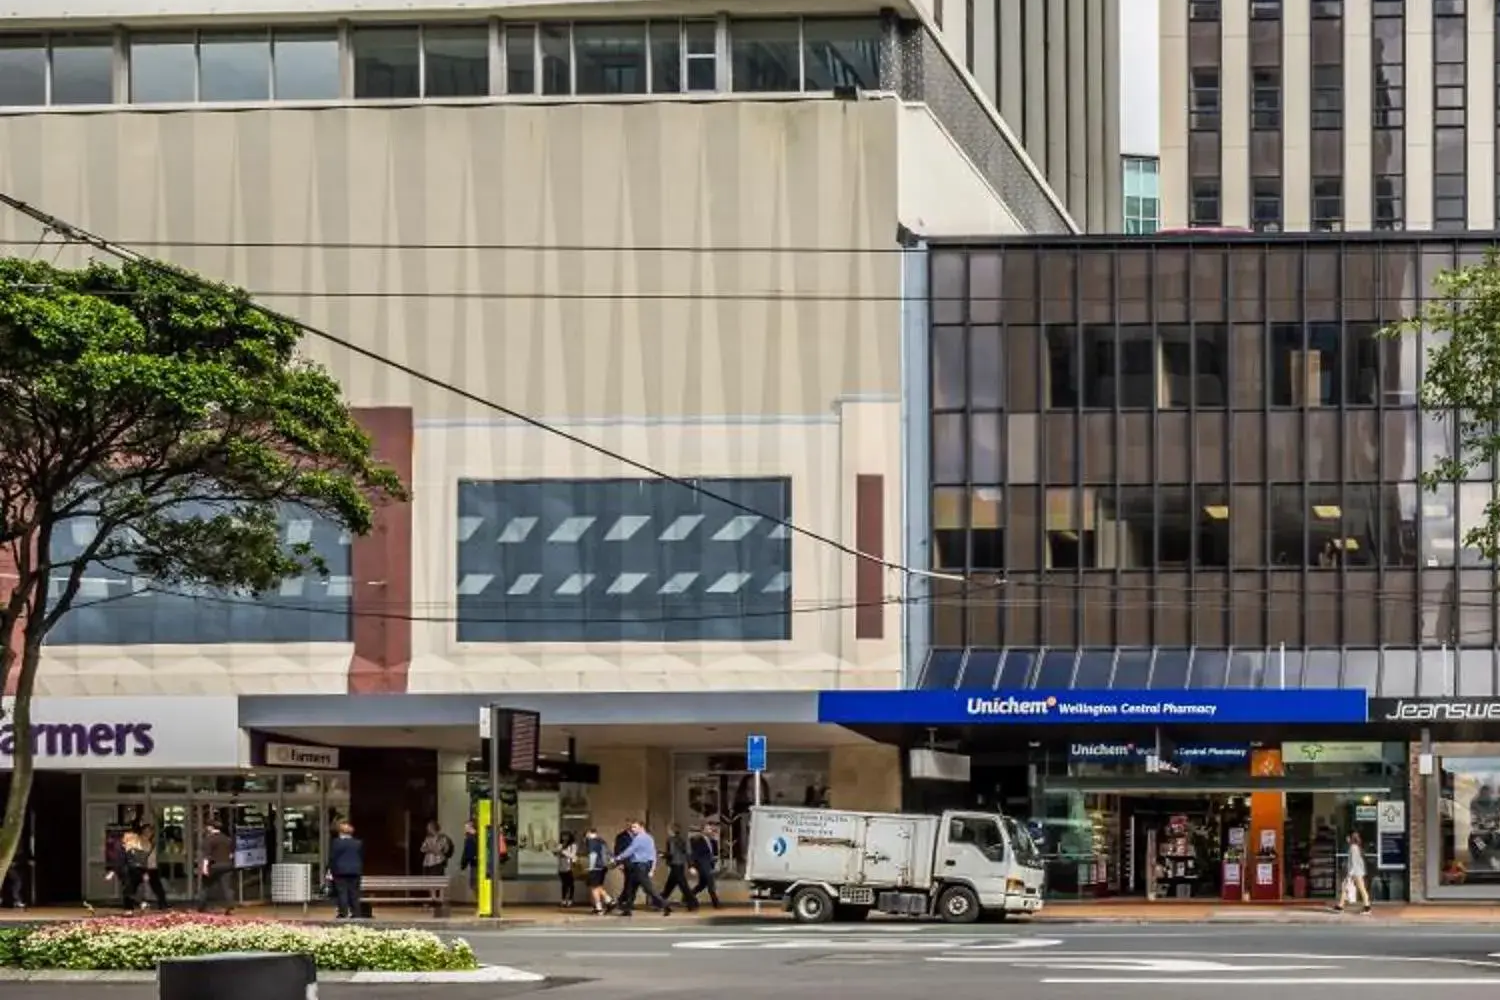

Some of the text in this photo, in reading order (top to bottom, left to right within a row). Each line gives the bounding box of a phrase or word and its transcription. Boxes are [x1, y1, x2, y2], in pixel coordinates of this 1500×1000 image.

[967, 697, 1217, 717] Unichem Wellington Central Pharmacy
[1072, 744, 1128, 756] Unichem
